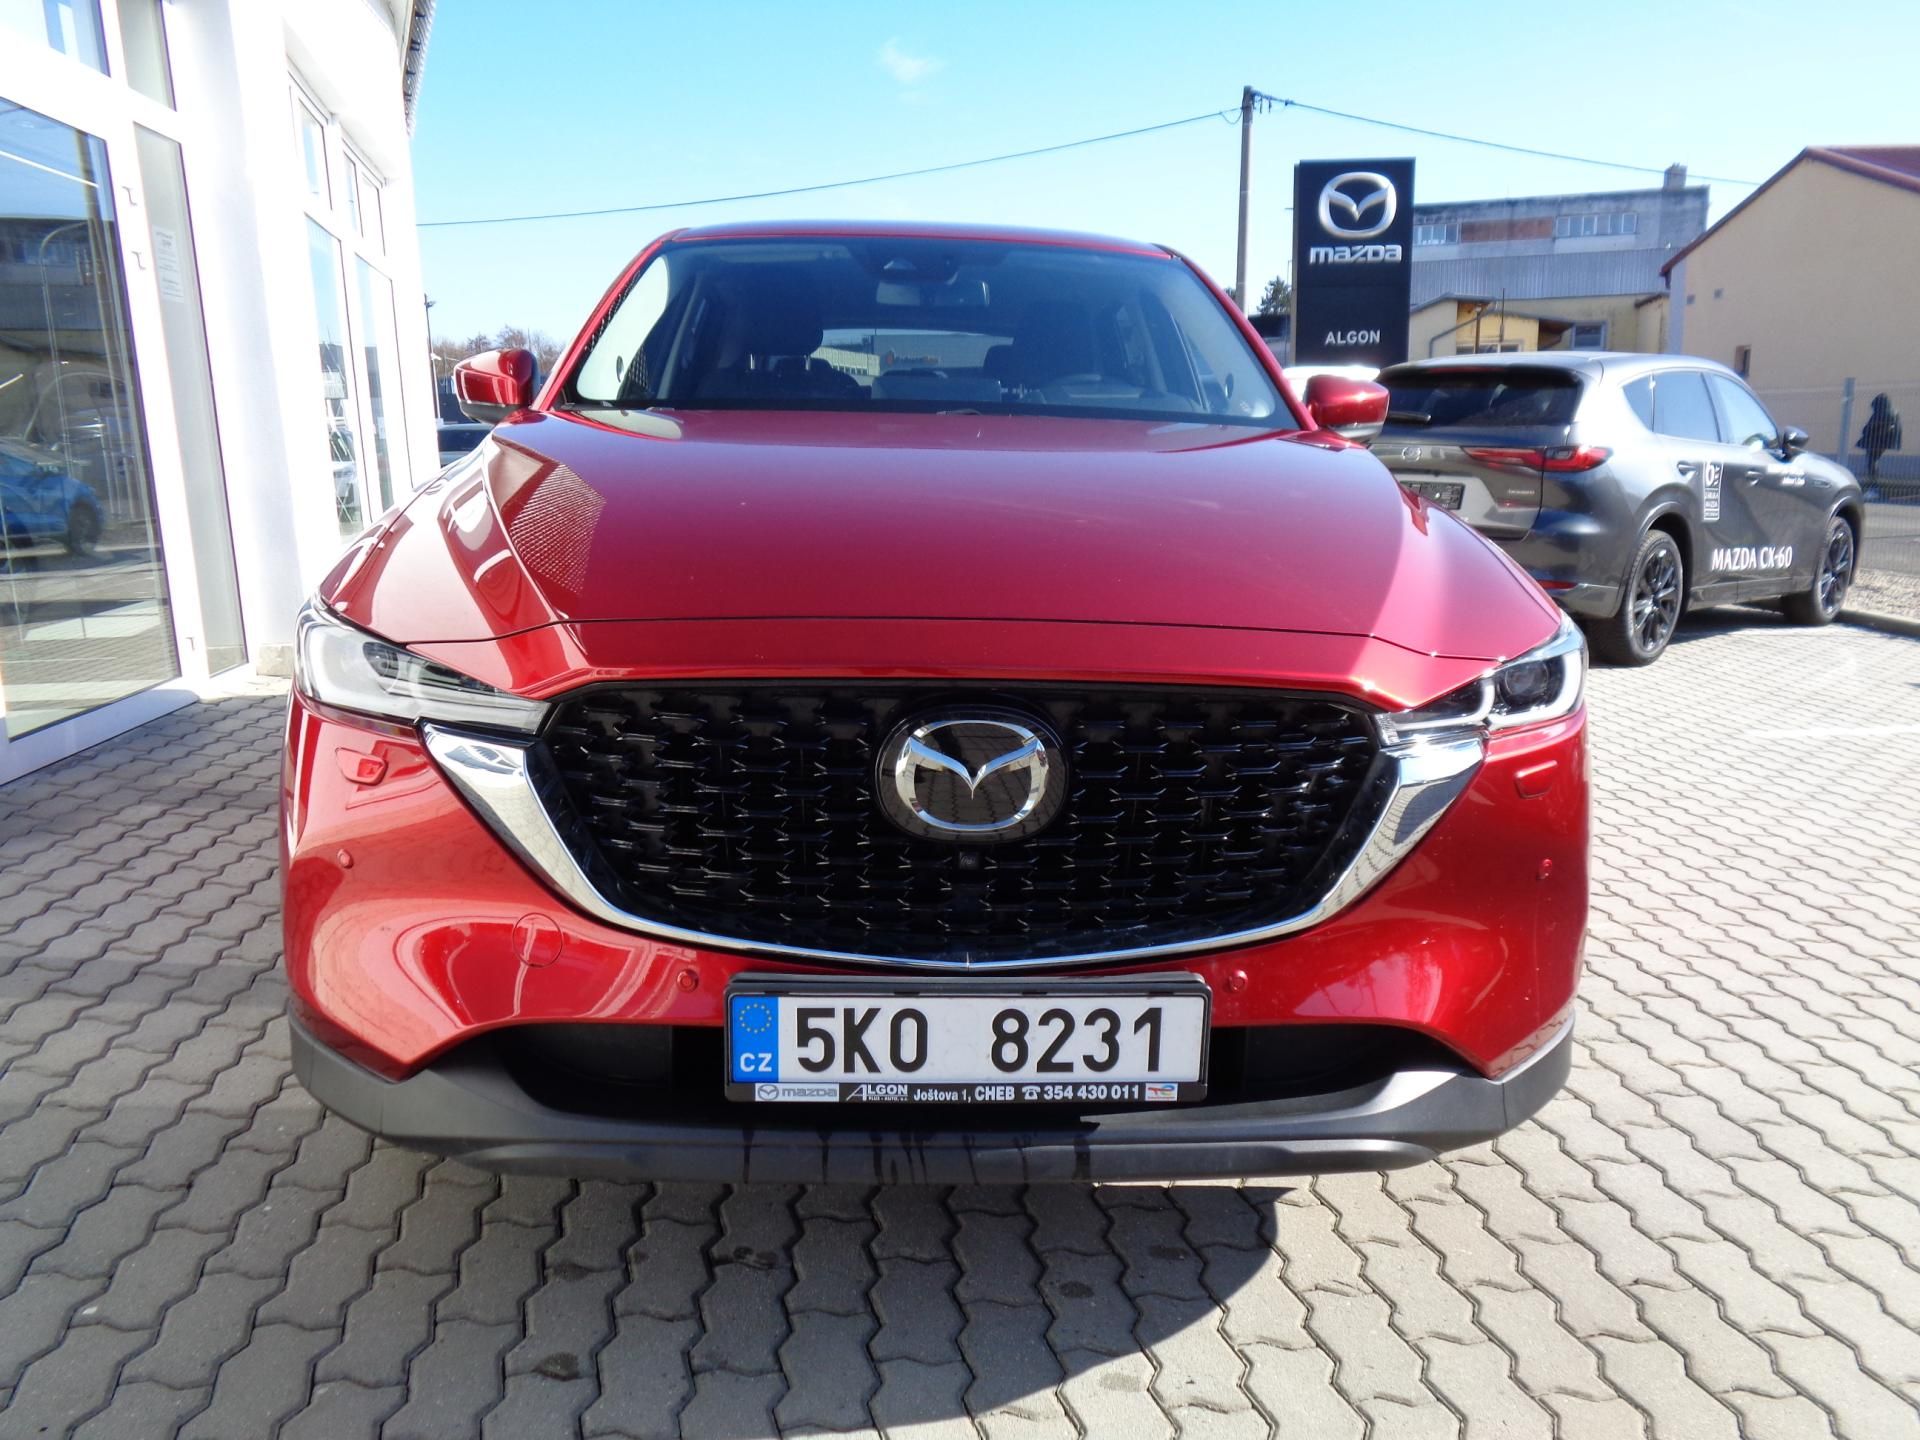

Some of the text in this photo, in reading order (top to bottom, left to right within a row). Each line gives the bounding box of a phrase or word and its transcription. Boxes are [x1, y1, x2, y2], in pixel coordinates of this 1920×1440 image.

[1325, 329, 1380, 344] ALGON
[1711, 545, 1793, 571] MAZDA CX-60
[990, 1007, 1163, 1073] 8231
[740, 1052, 772, 1072] CZ
[846, 1084, 908, 1101] ALGON
[914, 1088, 958, 1101] Joštova
[975, 1085, 1015, 1101] CHEB
[1043, 1085, 1073, 1100] 354
[1077, 1085, 1108, 1100] 430
[1111, 1085, 1139, 1100] 011
